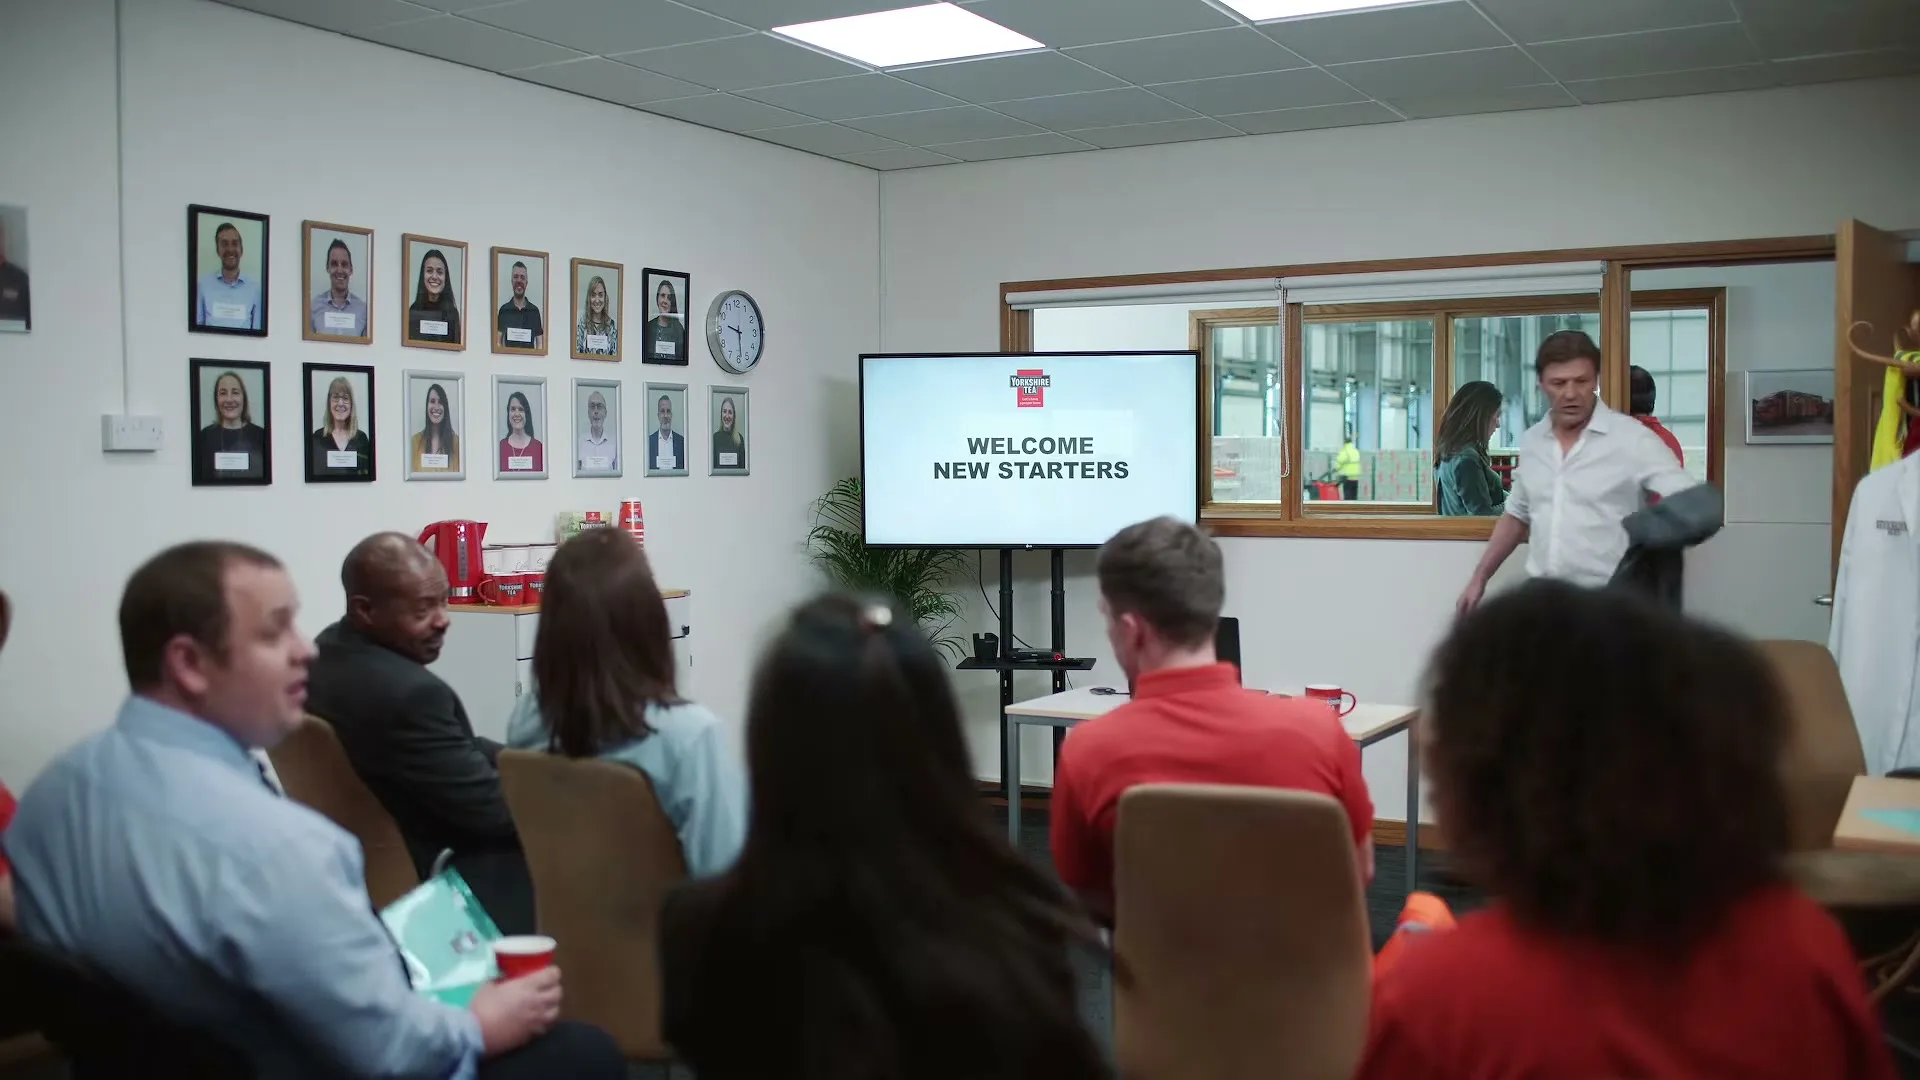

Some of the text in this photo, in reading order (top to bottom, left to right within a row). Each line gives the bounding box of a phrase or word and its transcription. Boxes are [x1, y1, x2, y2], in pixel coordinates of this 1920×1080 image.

[725, 303, 732, 311] 11
[733, 300, 740, 308] 12
[1011, 377, 1050, 387] YORKSHIRE
[1024, 386, 1037, 394] TEA
[967, 437, 1094, 455] WELCOME
[934, 461, 1129, 480] NEW STARTERS
